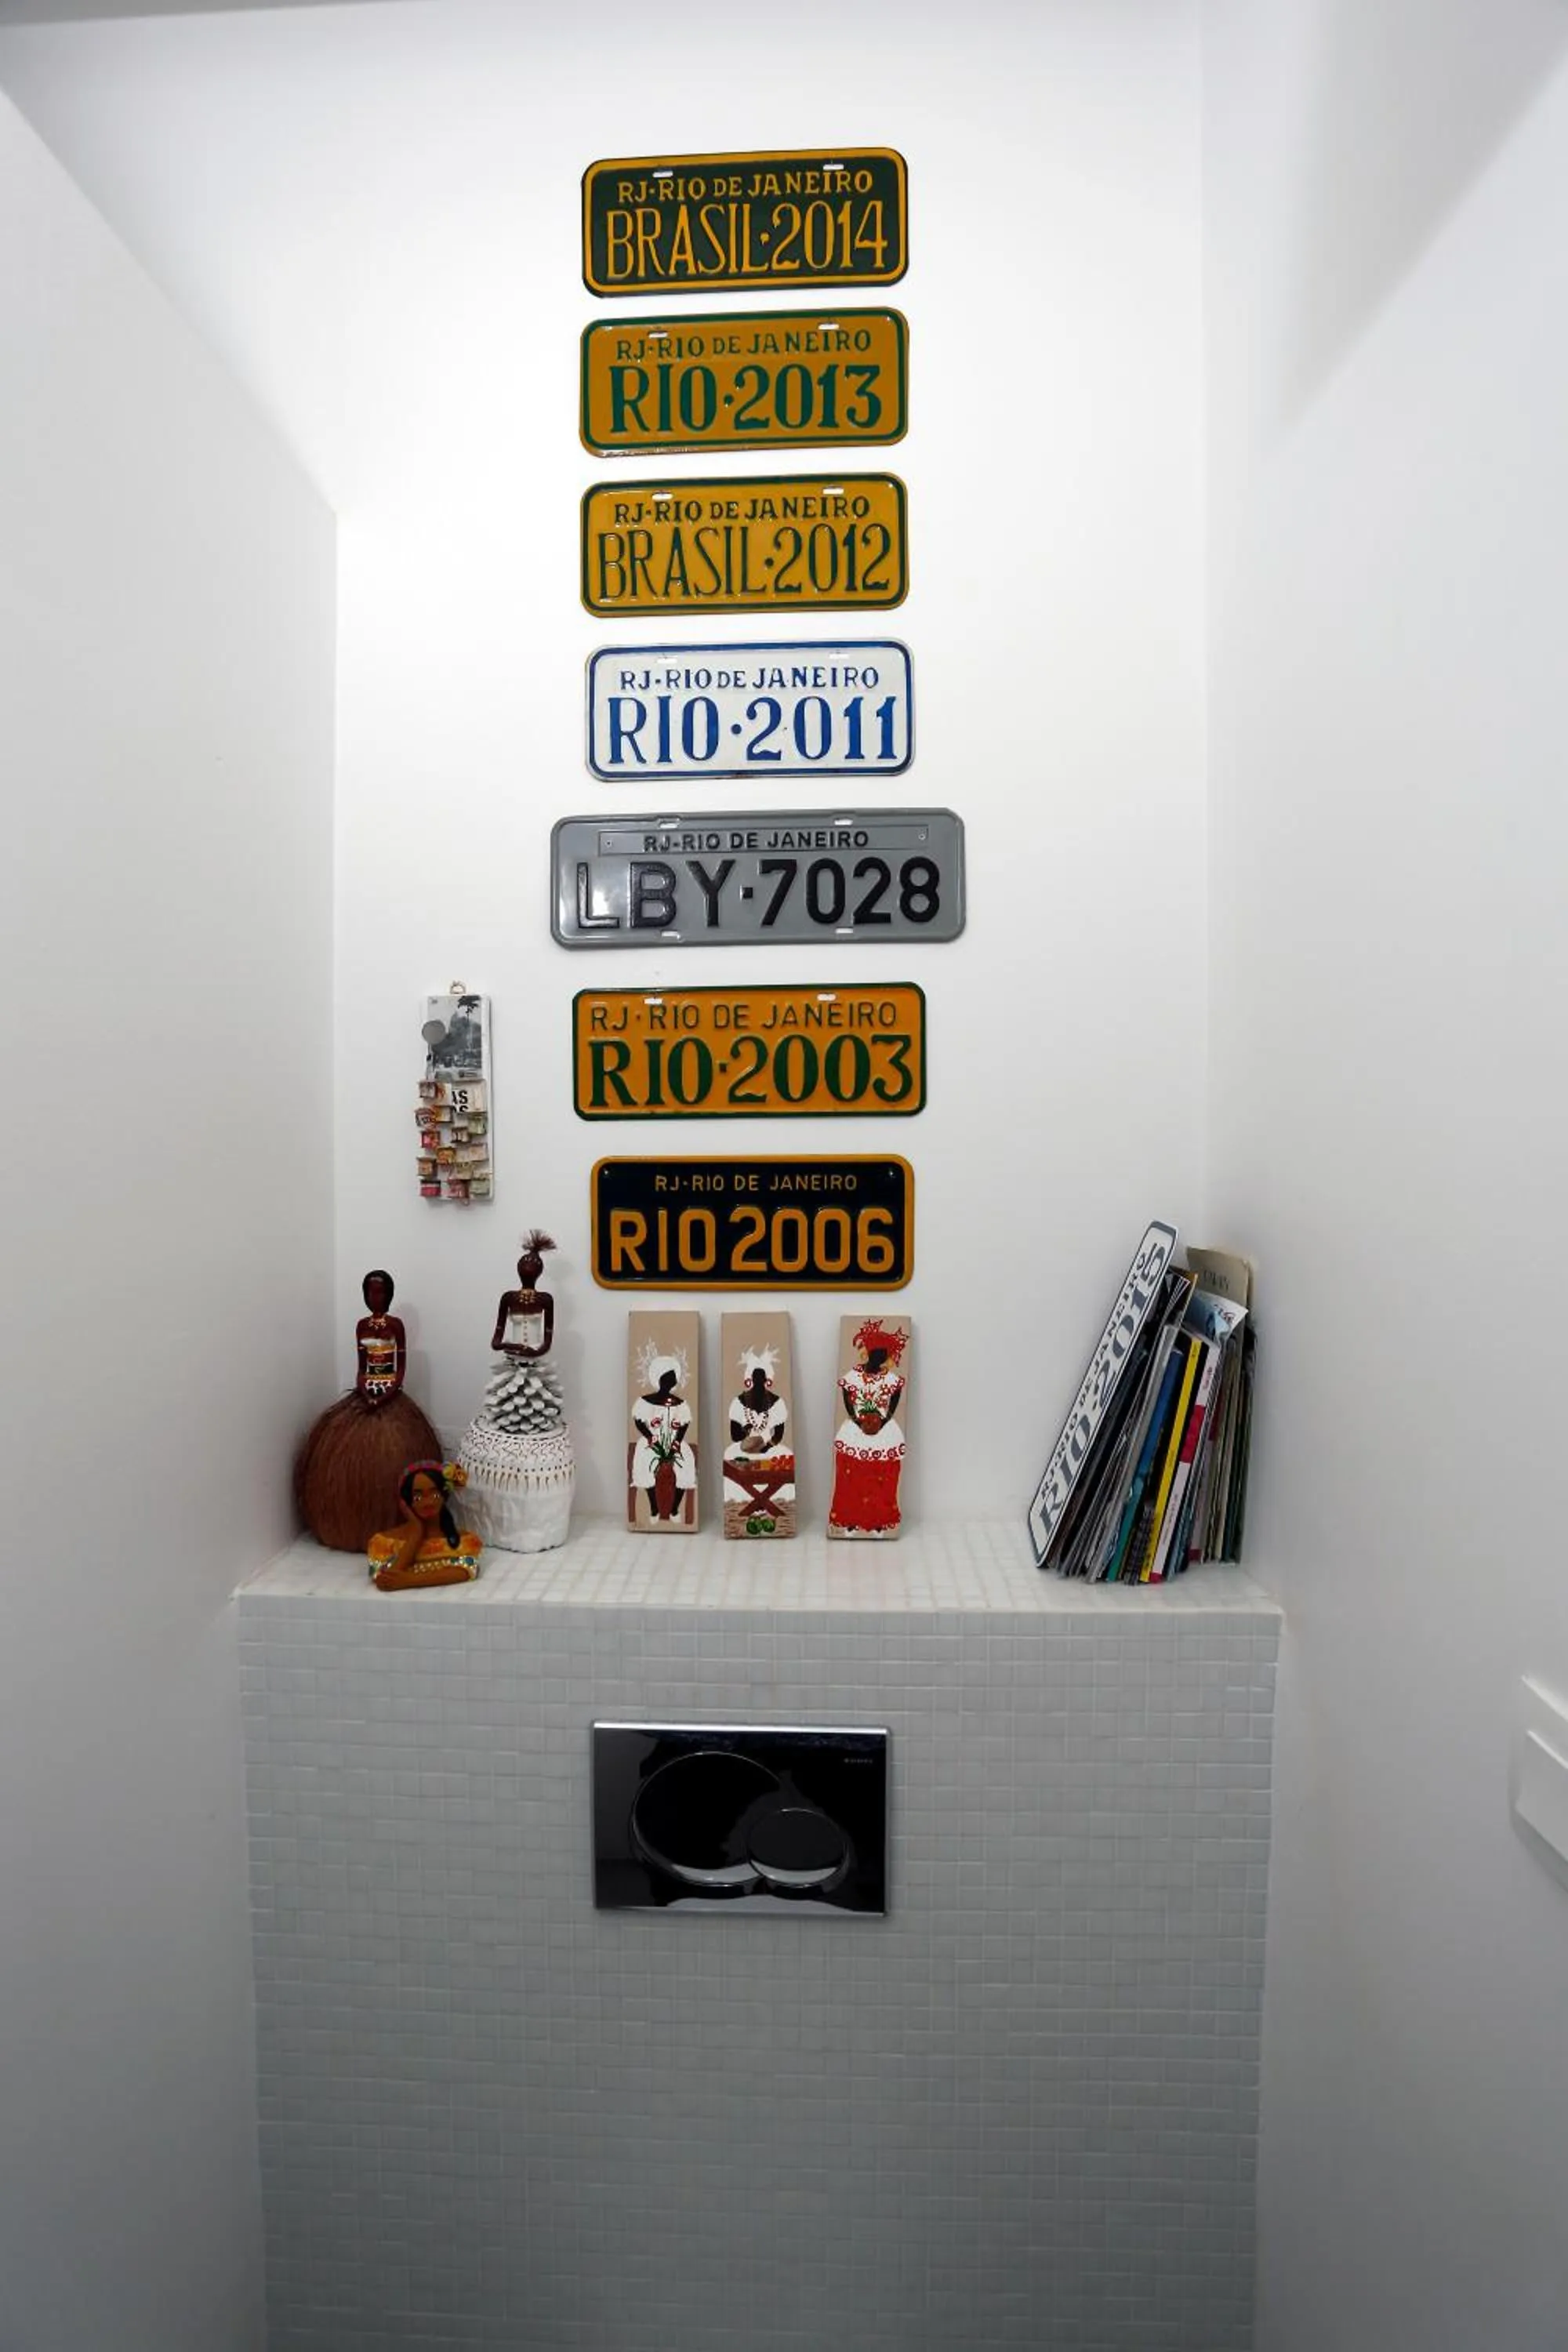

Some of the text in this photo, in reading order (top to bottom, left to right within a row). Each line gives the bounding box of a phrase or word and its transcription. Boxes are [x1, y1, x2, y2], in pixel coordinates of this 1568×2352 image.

[713, 176, 742, 198] DE
[747, 170, 873, 199] JANEIRO
[713, 336, 741, 355] DE
[747, 329, 872, 355] JANEIRO
[710, 500, 739, 521] DE
[745, 495, 870, 521] JANEIRO
[717, 669, 746, 689] DE
[752, 666, 880, 689] JANEIRO
[730, 832, 758, 850] DE
[767, 830, 869, 850] JANEIRO
[713, 1004, 750, 1029] DE
[762, 1000, 897, 1029] JANEIRO
[734, 1175, 759, 1191] DE
[770, 1174, 858, 1191] JANEIRO
[609, 1207, 895, 1273] RIO 2006
